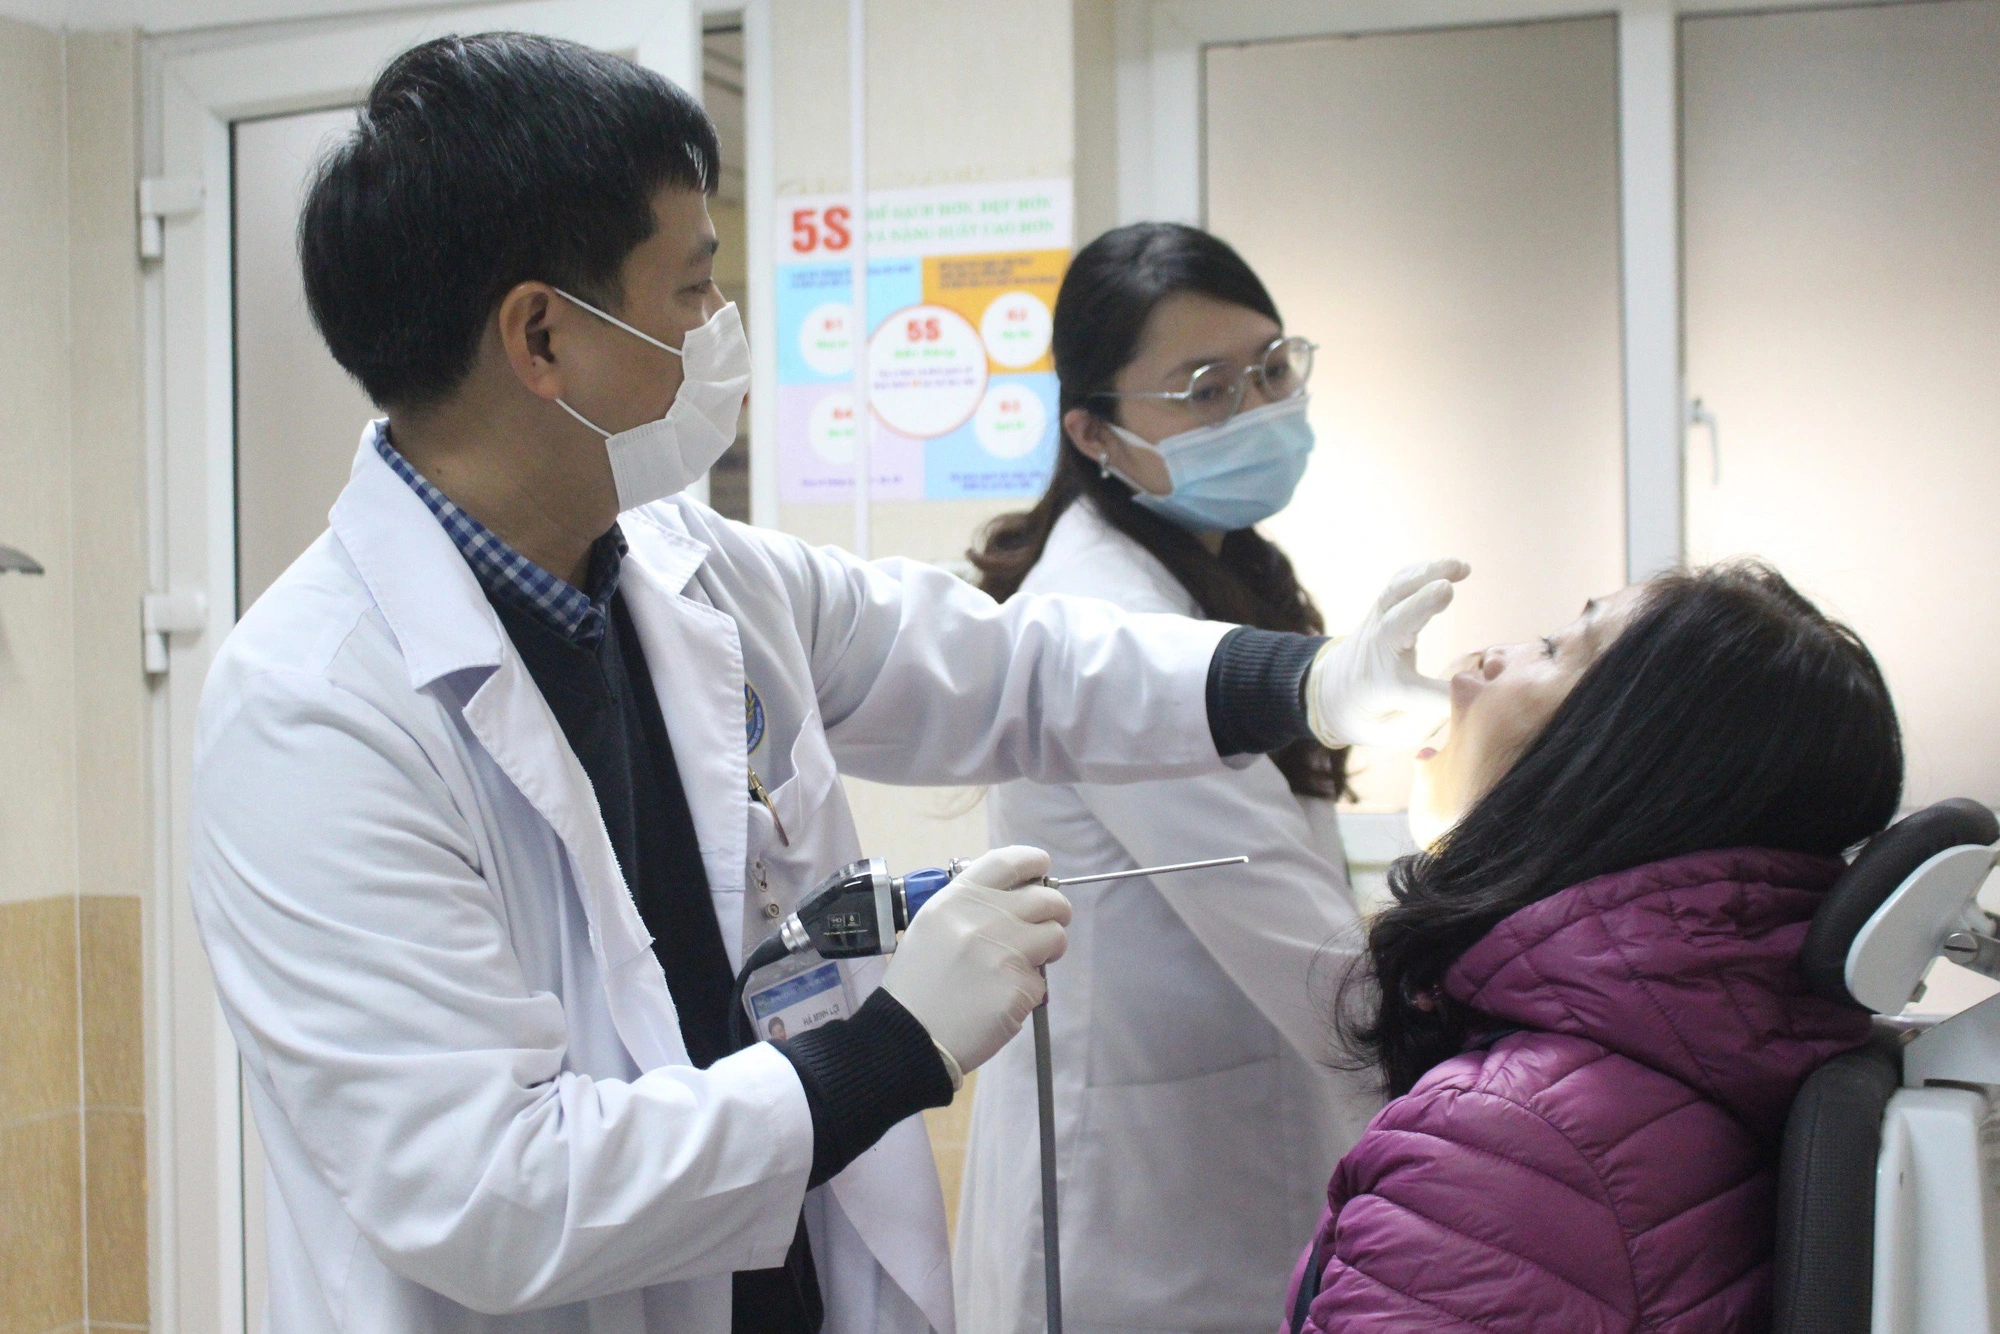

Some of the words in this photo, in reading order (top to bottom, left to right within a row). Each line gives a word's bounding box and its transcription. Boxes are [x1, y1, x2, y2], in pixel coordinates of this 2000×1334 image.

[792, 206, 852, 253] 5S
[907, 318, 940, 341] 5S
[813, 1009, 829, 1021] MINH
